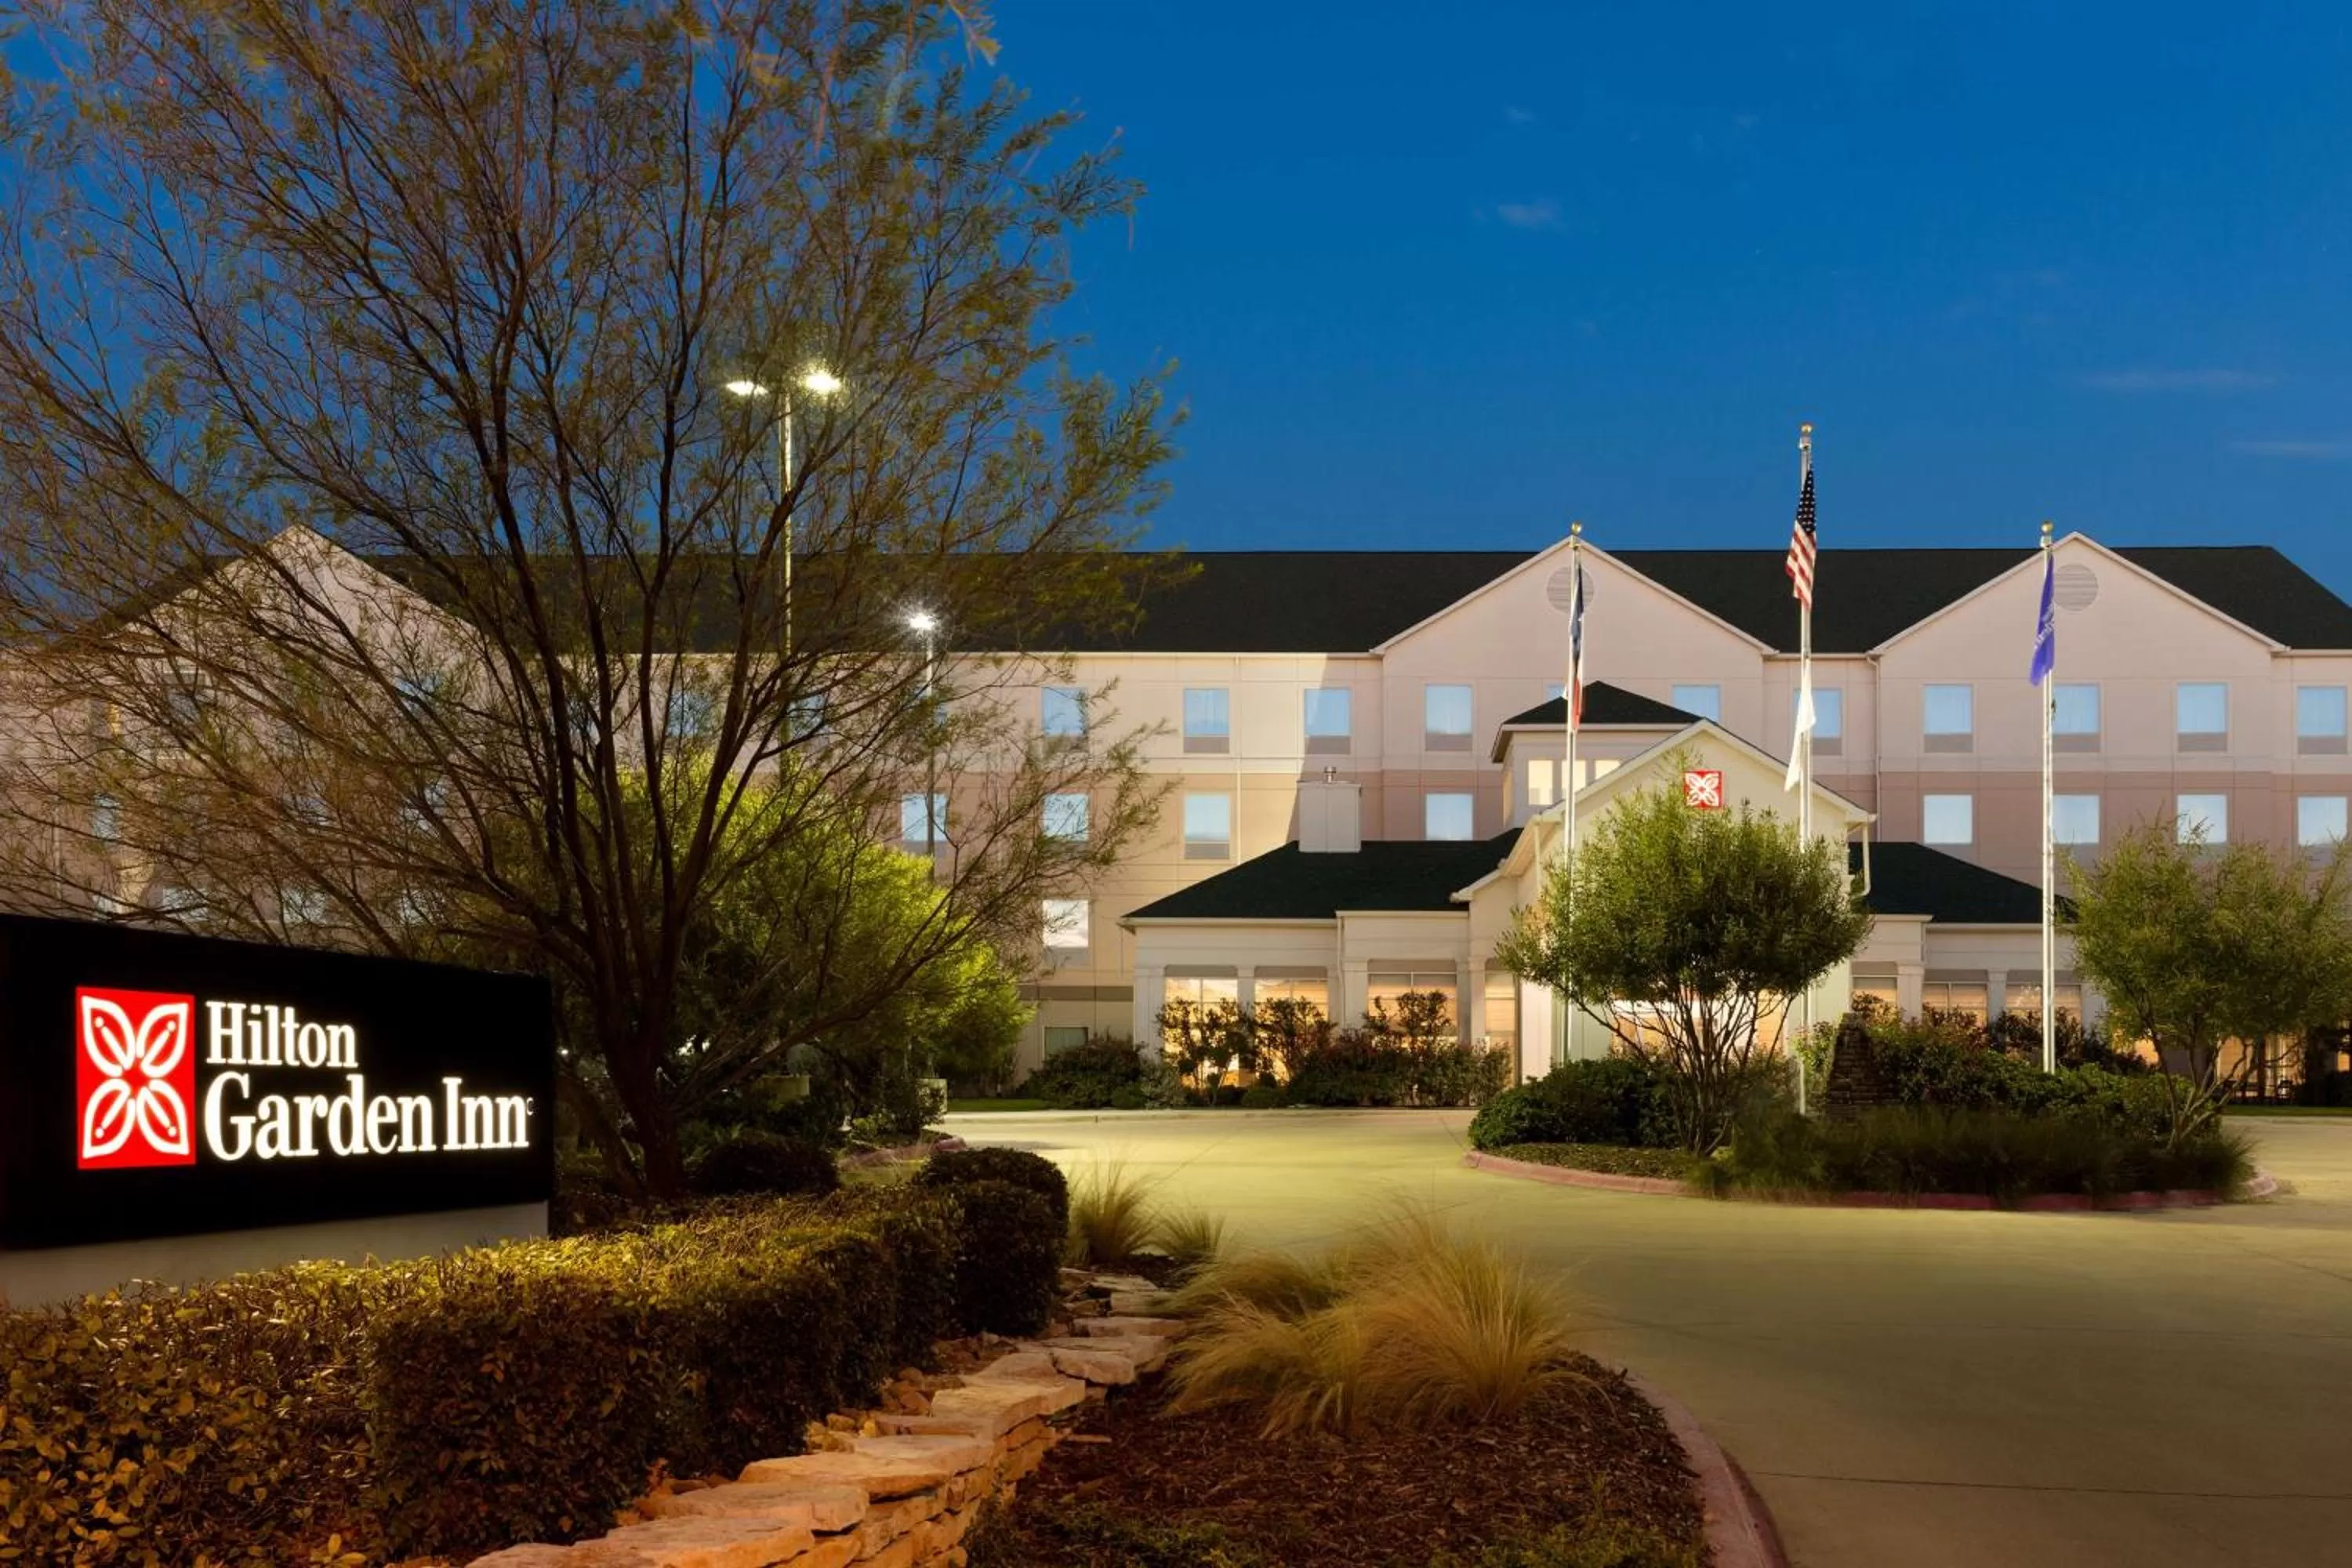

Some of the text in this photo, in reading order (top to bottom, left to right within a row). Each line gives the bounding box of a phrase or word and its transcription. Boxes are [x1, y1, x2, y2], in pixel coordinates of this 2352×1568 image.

[205, 1000, 359, 1069] Hilton
[204, 1071, 530, 1162] Garden Inn
